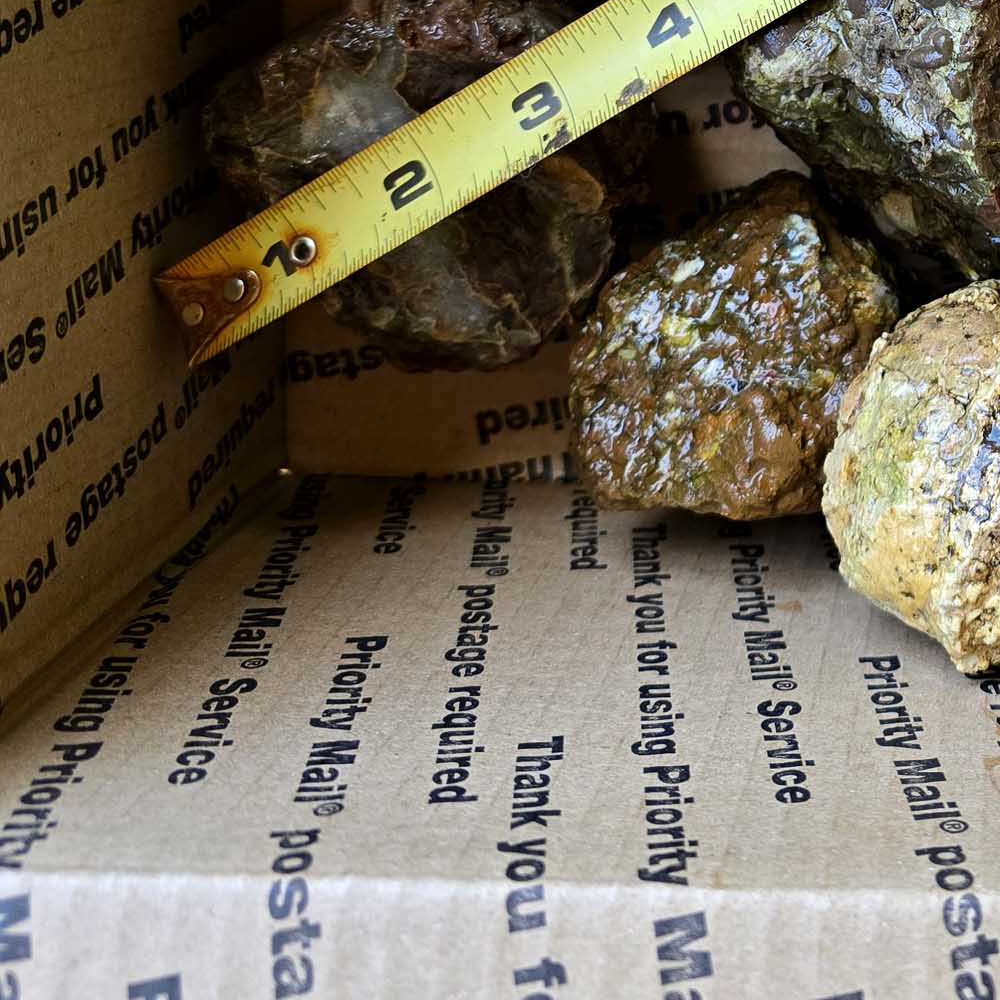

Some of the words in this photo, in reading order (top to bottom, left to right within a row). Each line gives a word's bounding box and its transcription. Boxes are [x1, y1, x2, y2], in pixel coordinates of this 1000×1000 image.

[110, 95, 160, 163] you
[383, 158, 435, 211] 2
[511, 80, 564, 132] 3
[645, 1, 695, 49] 4
[64, 144, 108, 204] for
[62, 401, 168, 547] postage
[242, 524, 319, 601] Priority
[564, 488, 608, 571] required
[631, 523, 673, 588] Thank
[625, 591, 668, 634] you
[728, 543, 777, 623] Priority
[224, 606, 288, 670] Mail®
[444, 583, 500, 678] postage
[637, 638, 679, 676] for
[743, 628, 799, 692] Mail®
[53, 655, 140, 732] using
[309, 634, 390, 731] Priority
[631, 682, 686, 757] using
[167, 677, 258, 785] Service
[427, 684, 486, 804] required
[756, 699, 817, 804] Service
[857, 654, 926, 751] Priority
[892, 756, 971, 834] Mail®
[293, 739, 361, 817] Mail®
[508, 734, 566, 831] Thank
[636, 763, 700, 887] Priority
[496, 836, 549, 934] you
